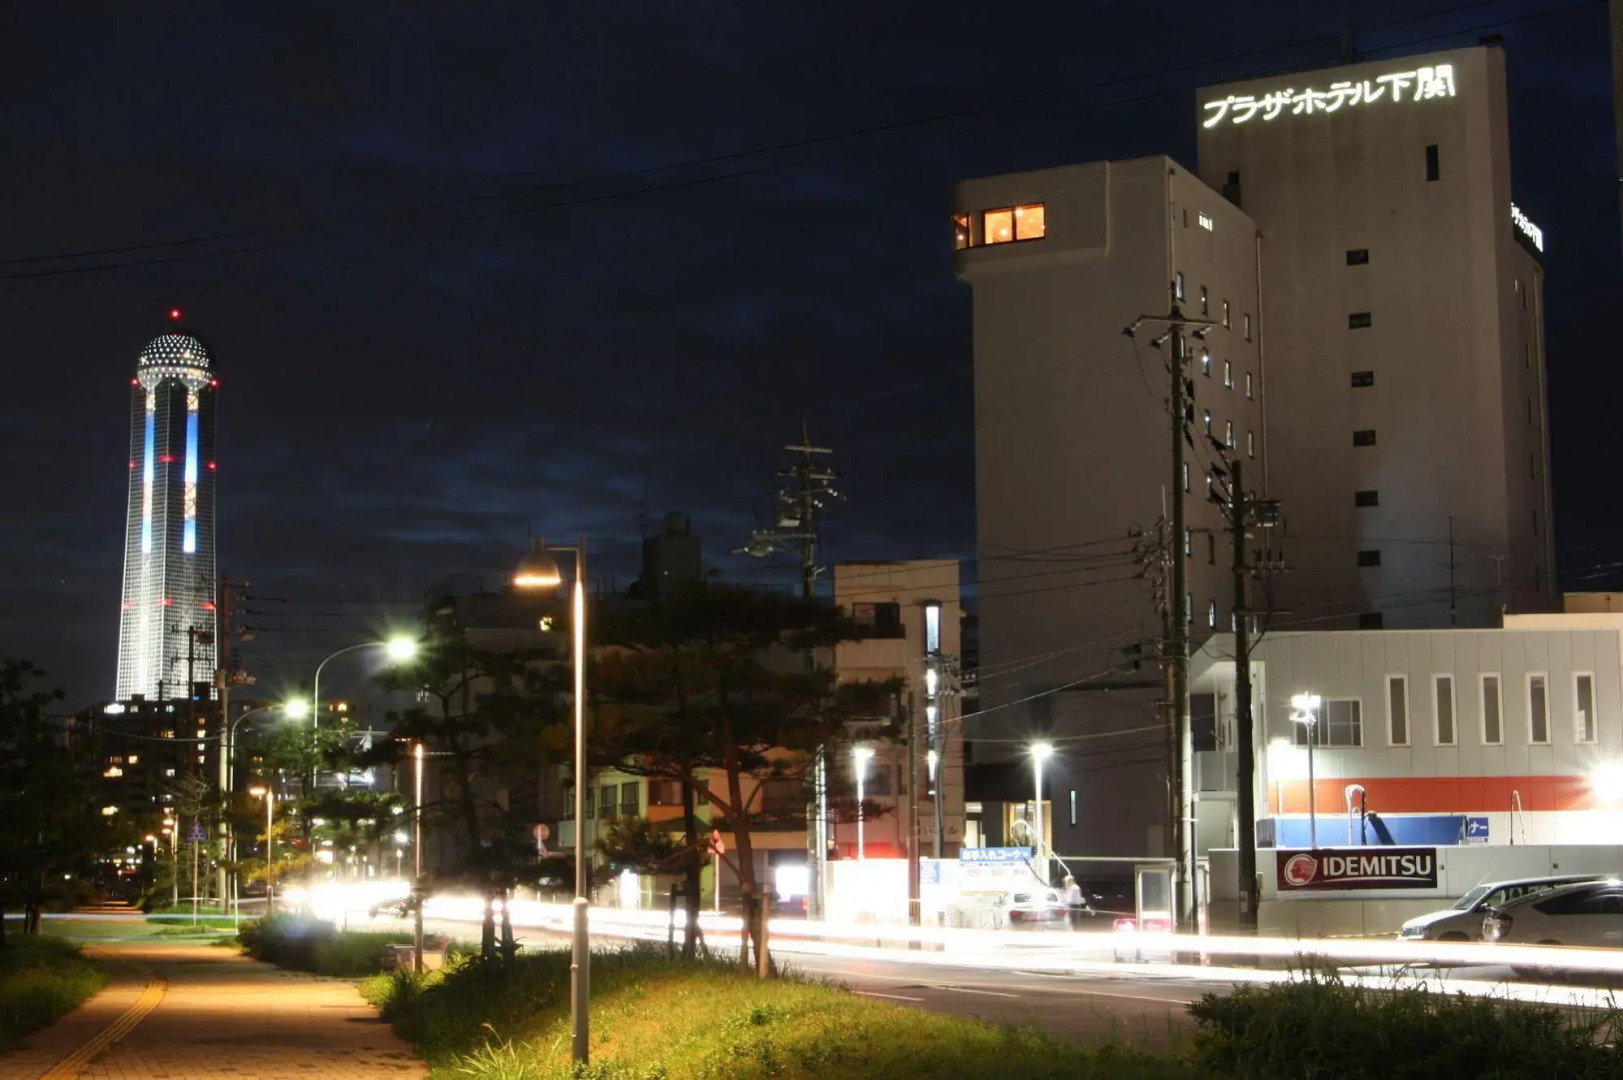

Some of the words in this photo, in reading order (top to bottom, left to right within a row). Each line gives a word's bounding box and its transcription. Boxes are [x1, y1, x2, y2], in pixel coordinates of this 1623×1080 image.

[1203, 64, 1456, 128] プラザホテル下関
[1323, 855, 1432, 877] IDEMITSU
